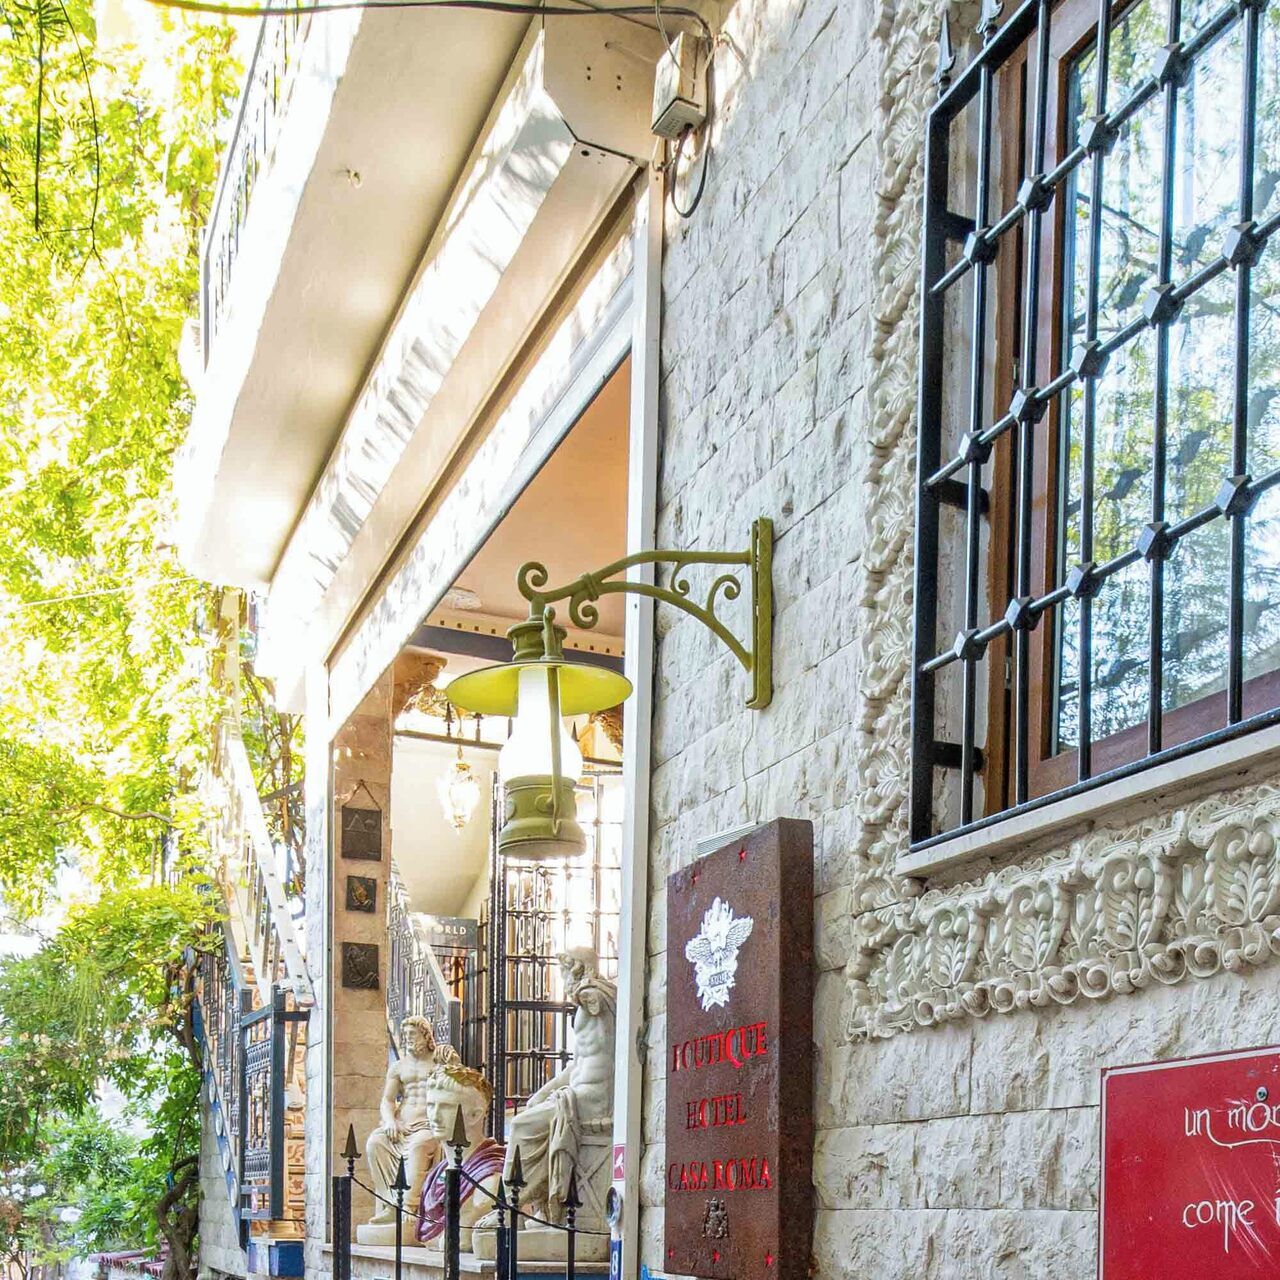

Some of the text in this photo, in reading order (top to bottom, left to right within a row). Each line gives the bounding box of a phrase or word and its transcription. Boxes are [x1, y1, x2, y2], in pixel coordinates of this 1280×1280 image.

[686, 1090, 747, 1131] HOTEL
[668, 1153, 773, 1192] CASA ROMA
[1182, 1199, 1256, 1254] come
